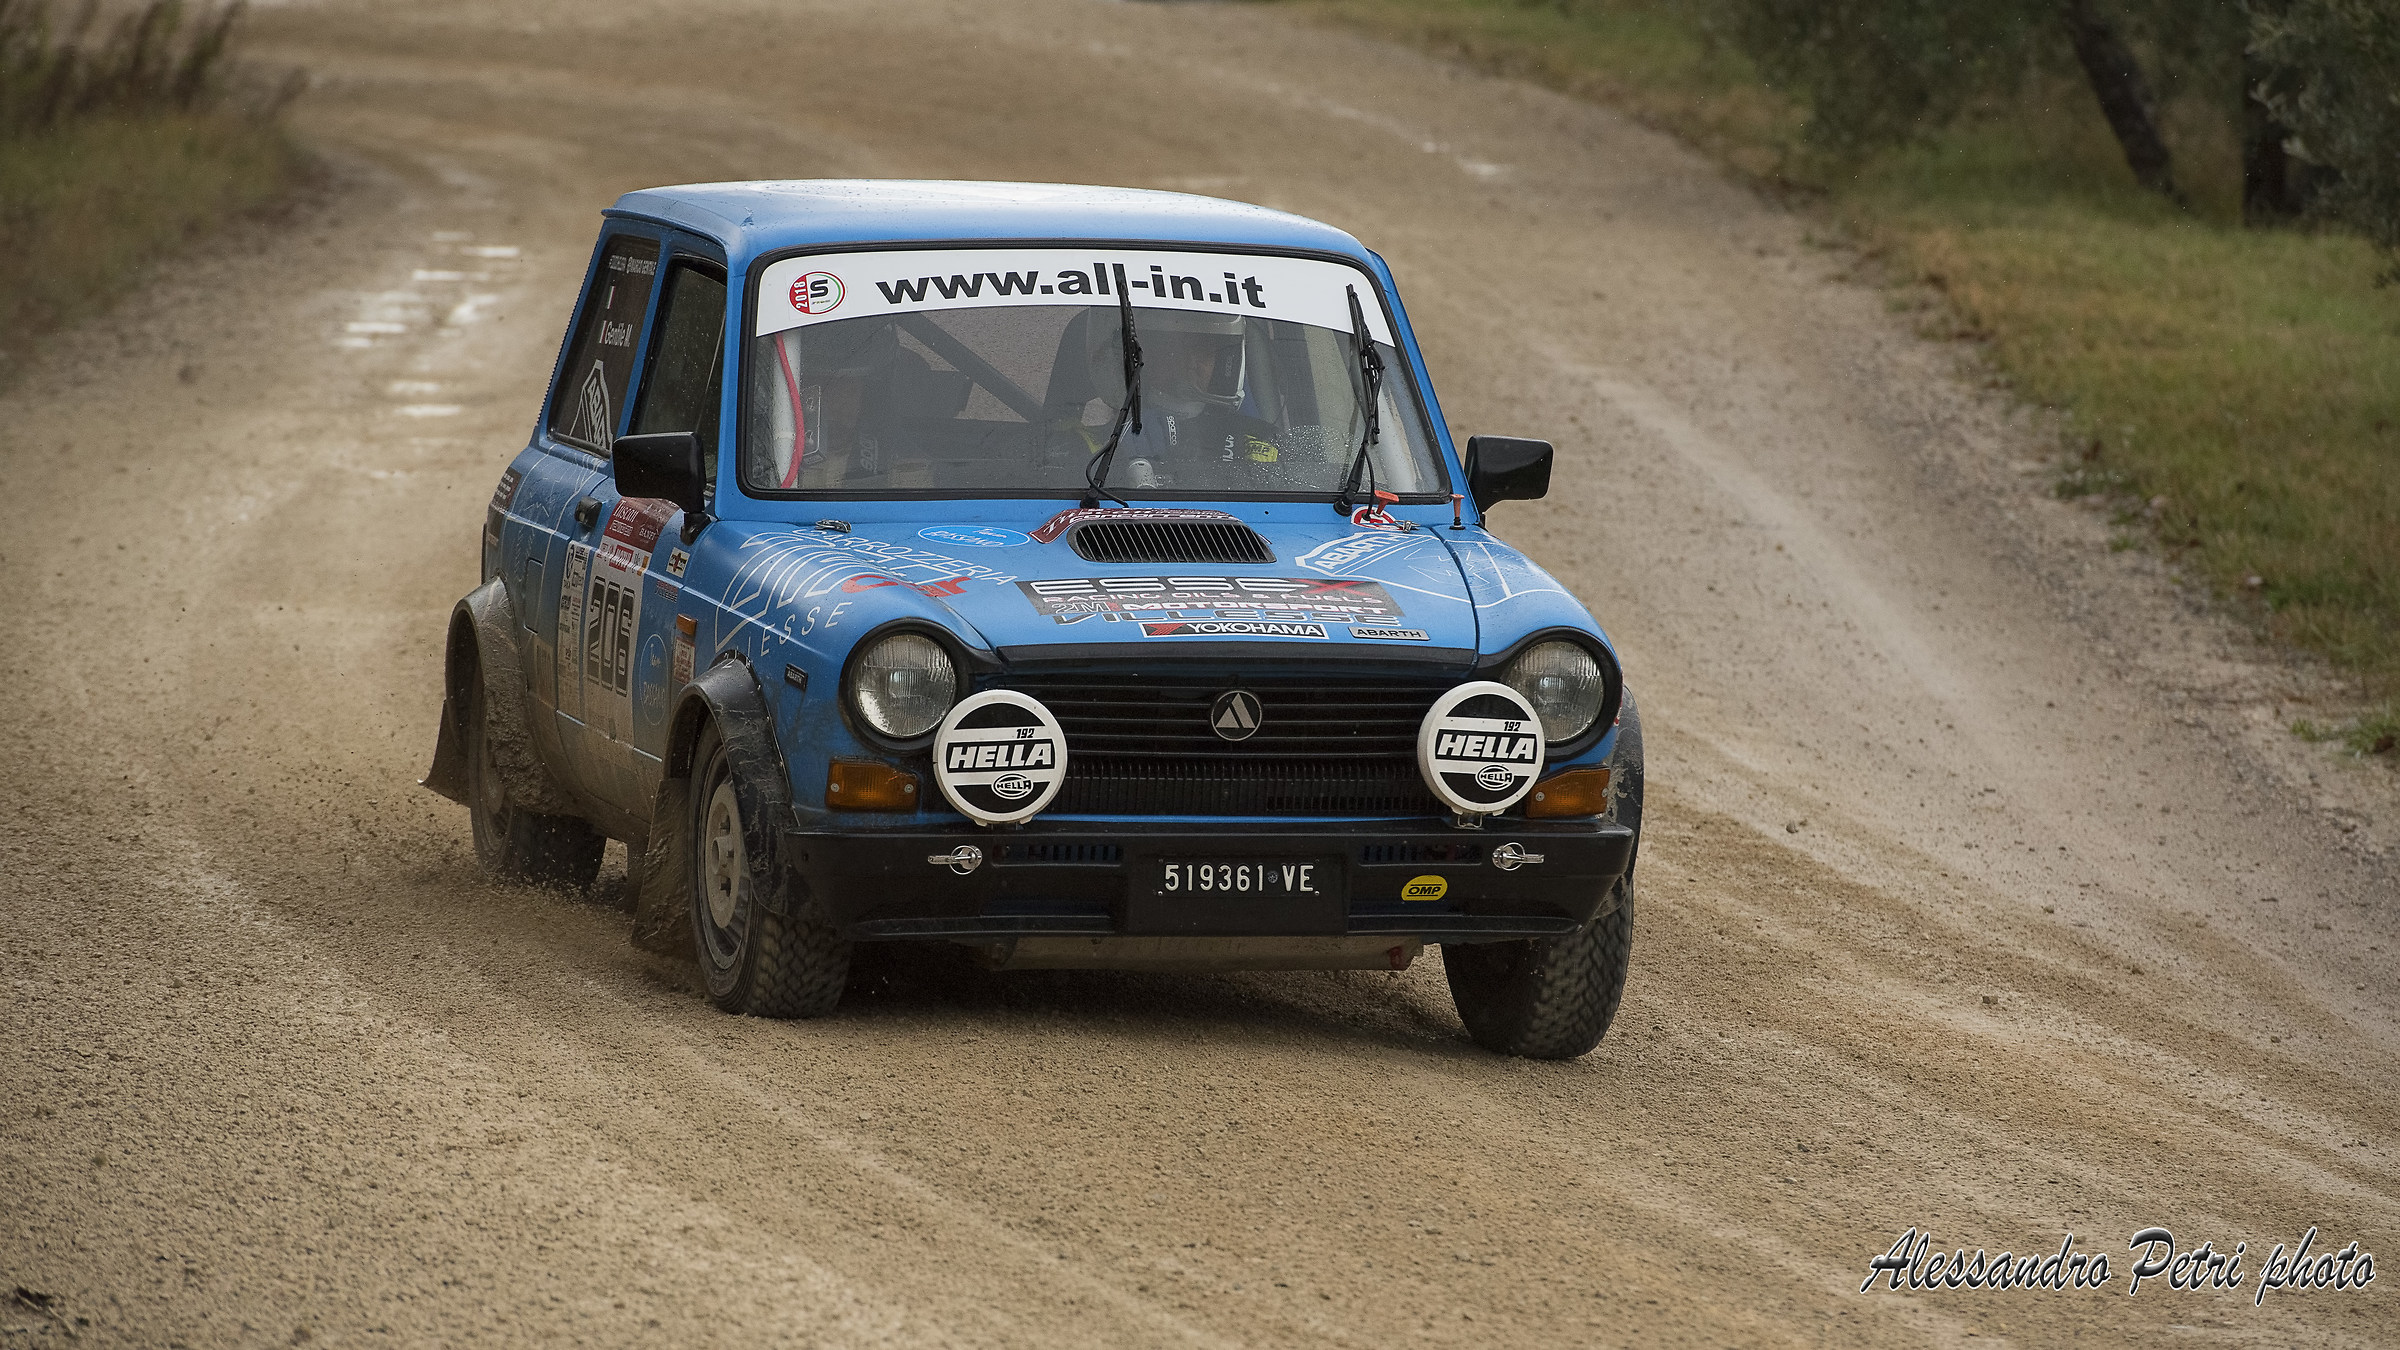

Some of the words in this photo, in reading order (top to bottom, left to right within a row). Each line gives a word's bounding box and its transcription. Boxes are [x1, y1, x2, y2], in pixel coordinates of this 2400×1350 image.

[875, 262, 1267, 309] www.all-in.it
[793, 281, 808, 309] 2018
[613, 499, 640, 523] Tuscan
[1315, 534, 1409, 569] ABARTH
[1030, 577, 1373, 596] ESSEX
[1042, 593, 1160, 603] RACING
[1281, 594, 1382, 604] FUELS
[1121, 601, 1388, 615] MOTORSPORT
[1052, 609, 1402, 627] VILLESSE
[587, 575, 635, 698] 206
[1186, 622, 1323, 636] YOKOHAMA
[1357, 629, 1422, 638] ABARTH
[1016, 728, 1035, 739] 192
[1504, 721, 1522, 732] 192
[1437, 733, 1536, 760] HELLA
[948, 743, 1052, 769] HELLA
[996, 780, 1032, 790] HELLA
[1480, 772, 1513, 783] HELLA
[1165, 864, 1264, 891] 519361
[1282, 864, 1315, 891] VE
[1408, 885, 1441, 895] OMP
